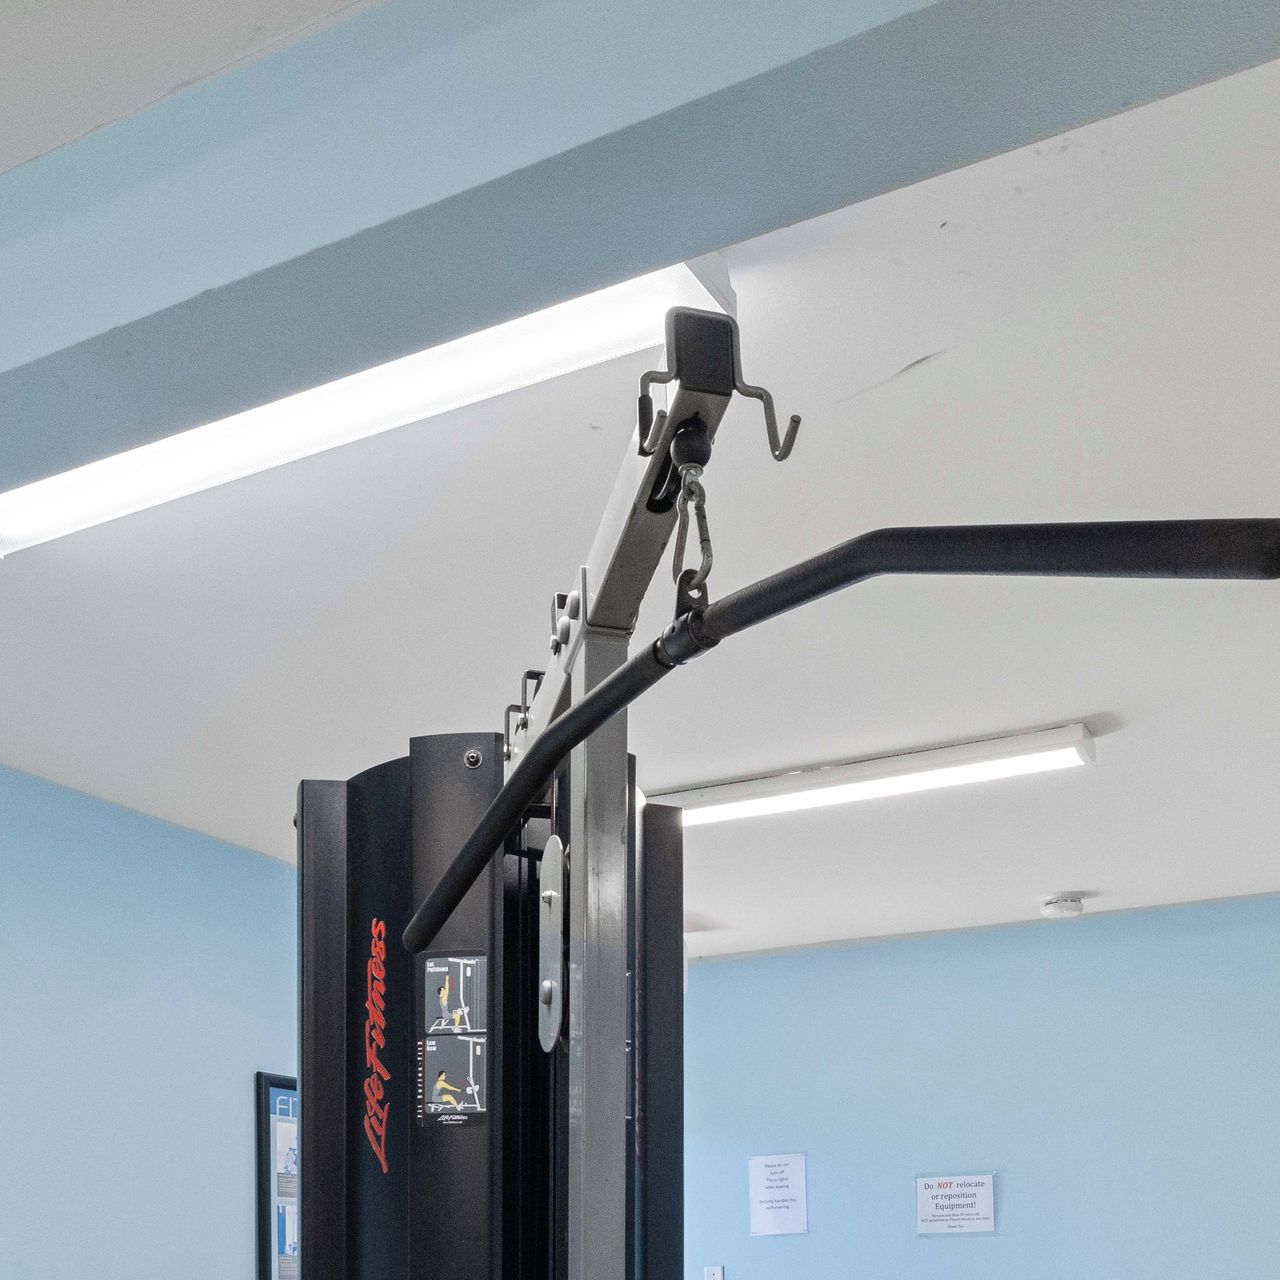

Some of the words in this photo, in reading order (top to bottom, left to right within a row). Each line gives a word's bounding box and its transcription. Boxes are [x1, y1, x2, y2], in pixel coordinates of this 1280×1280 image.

[924, 1182, 934, 1190] Do
[937, 1181, 953, 1189] NOT
[956, 1180, 985, 1188] relocate
[940, 1192, 977, 1201] reposition
[935, 1201, 976, 1211] Equipment!
